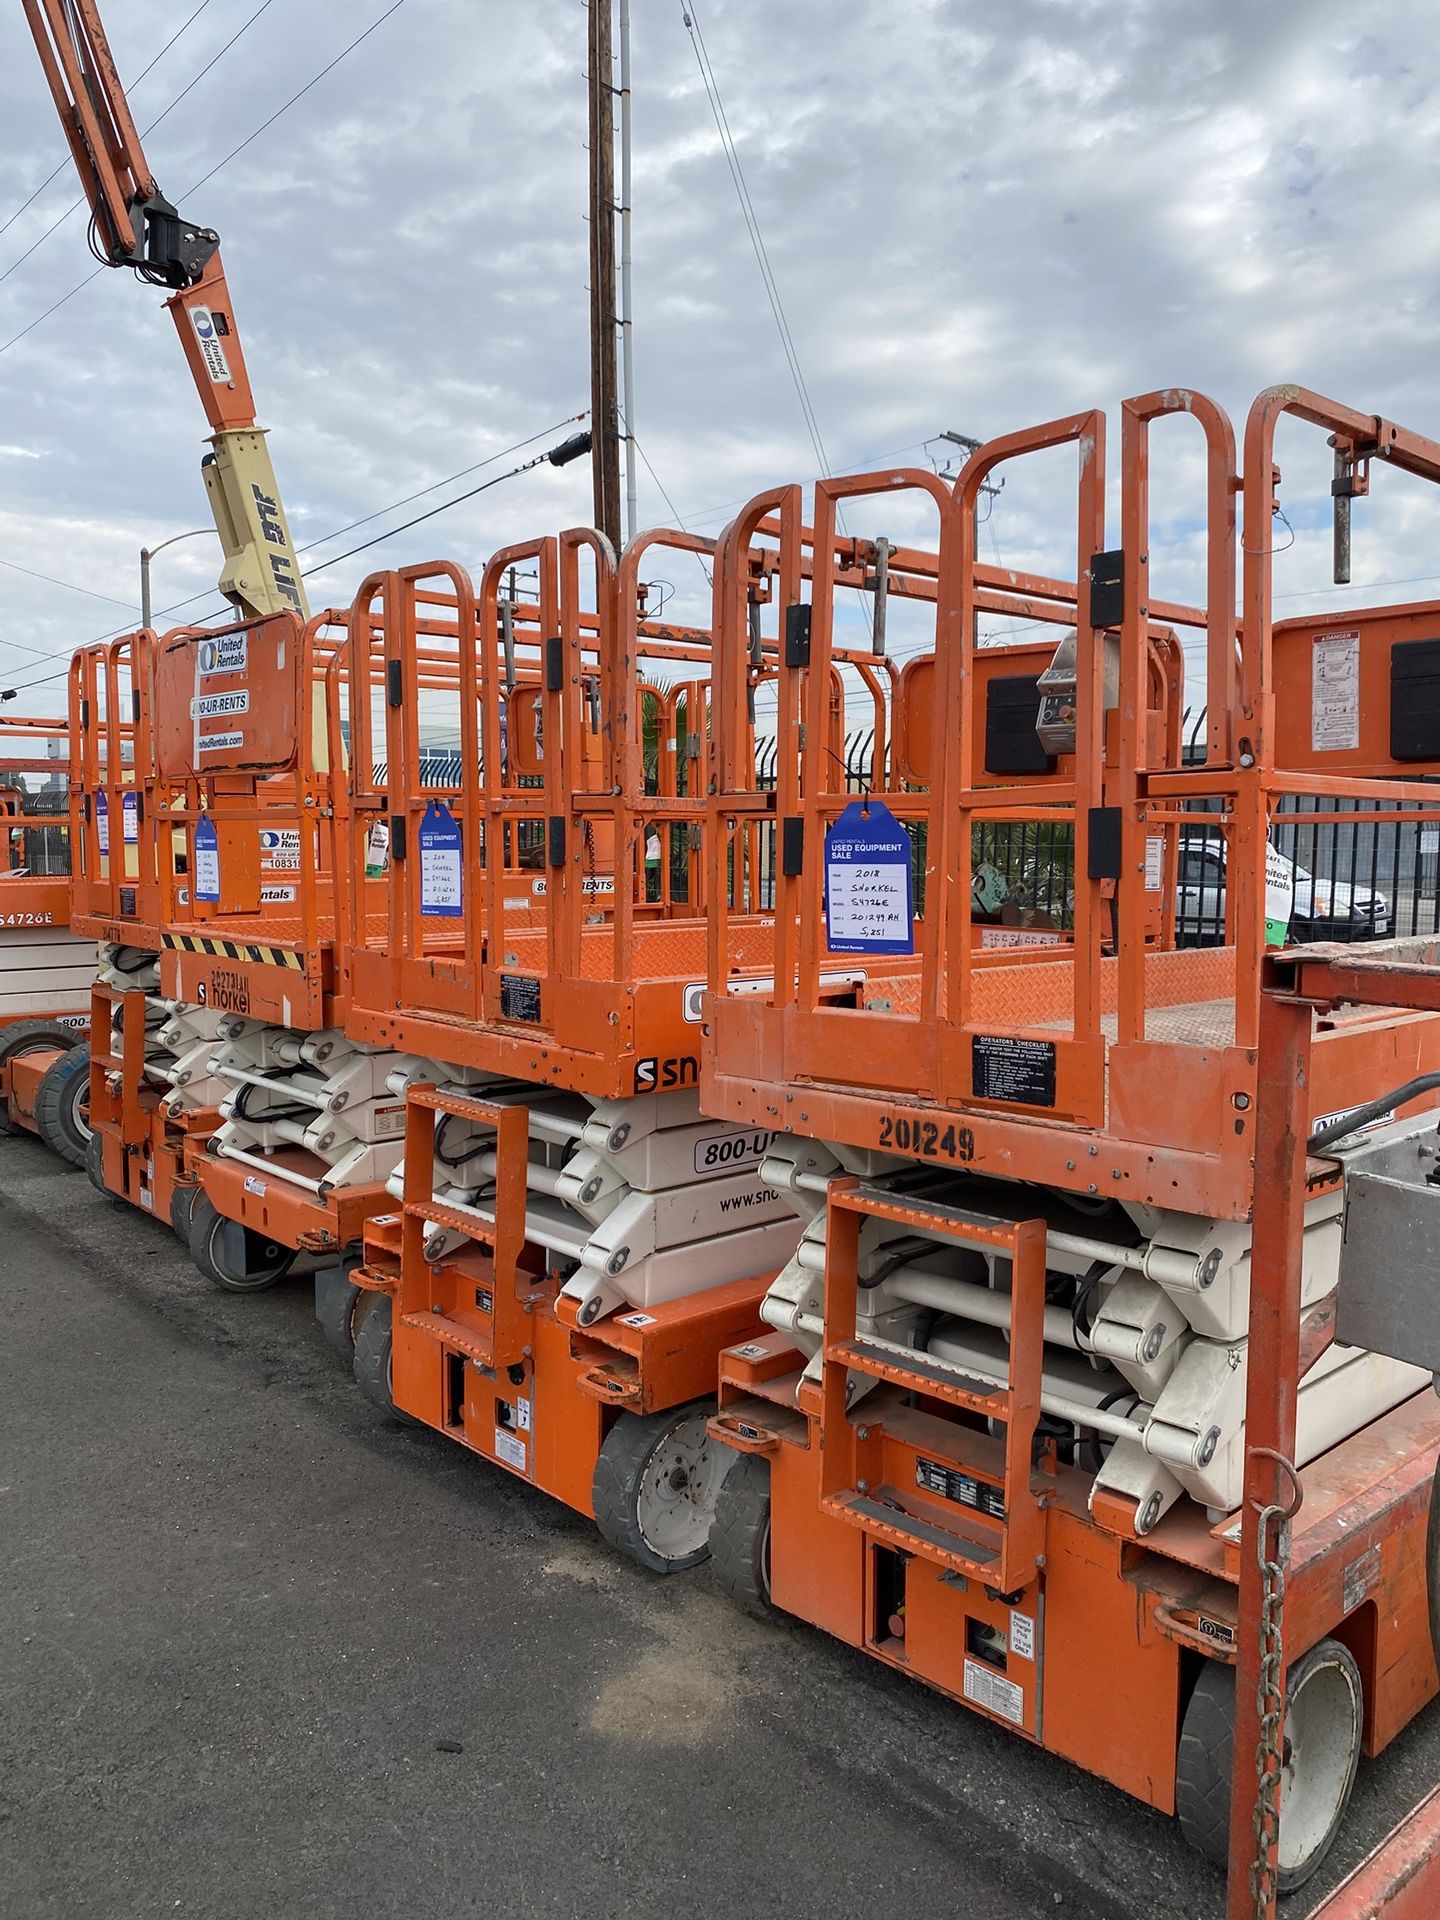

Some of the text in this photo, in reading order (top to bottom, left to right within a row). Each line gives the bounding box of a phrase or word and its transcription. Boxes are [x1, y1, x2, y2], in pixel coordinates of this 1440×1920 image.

[201, 340, 220, 379] Rentals
[210, 339, 228, 375] United
[251, 484, 287, 546] JLG
[217, 637, 243, 653] United
[216, 652, 245, 668] Rentals
[198, 736, 243, 749] nitedRentals.com
[831, 843, 903, 852] USED EQUIPMENT
[831, 852, 852, 860] SALE
[855, 869, 880, 878] 2018
[1265, 868, 1288, 880] nited
[850, 882, 899, 892] SNORKEL
[1265, 878, 1290, 891] ntals
[261, 888, 290, 899] ntals
[851, 898, 889, 907] S4726E
[661, 1056, 701, 1087] sn
[879, 1116, 974, 1161] 201249
[720, 1189, 782, 1212] www.sno
